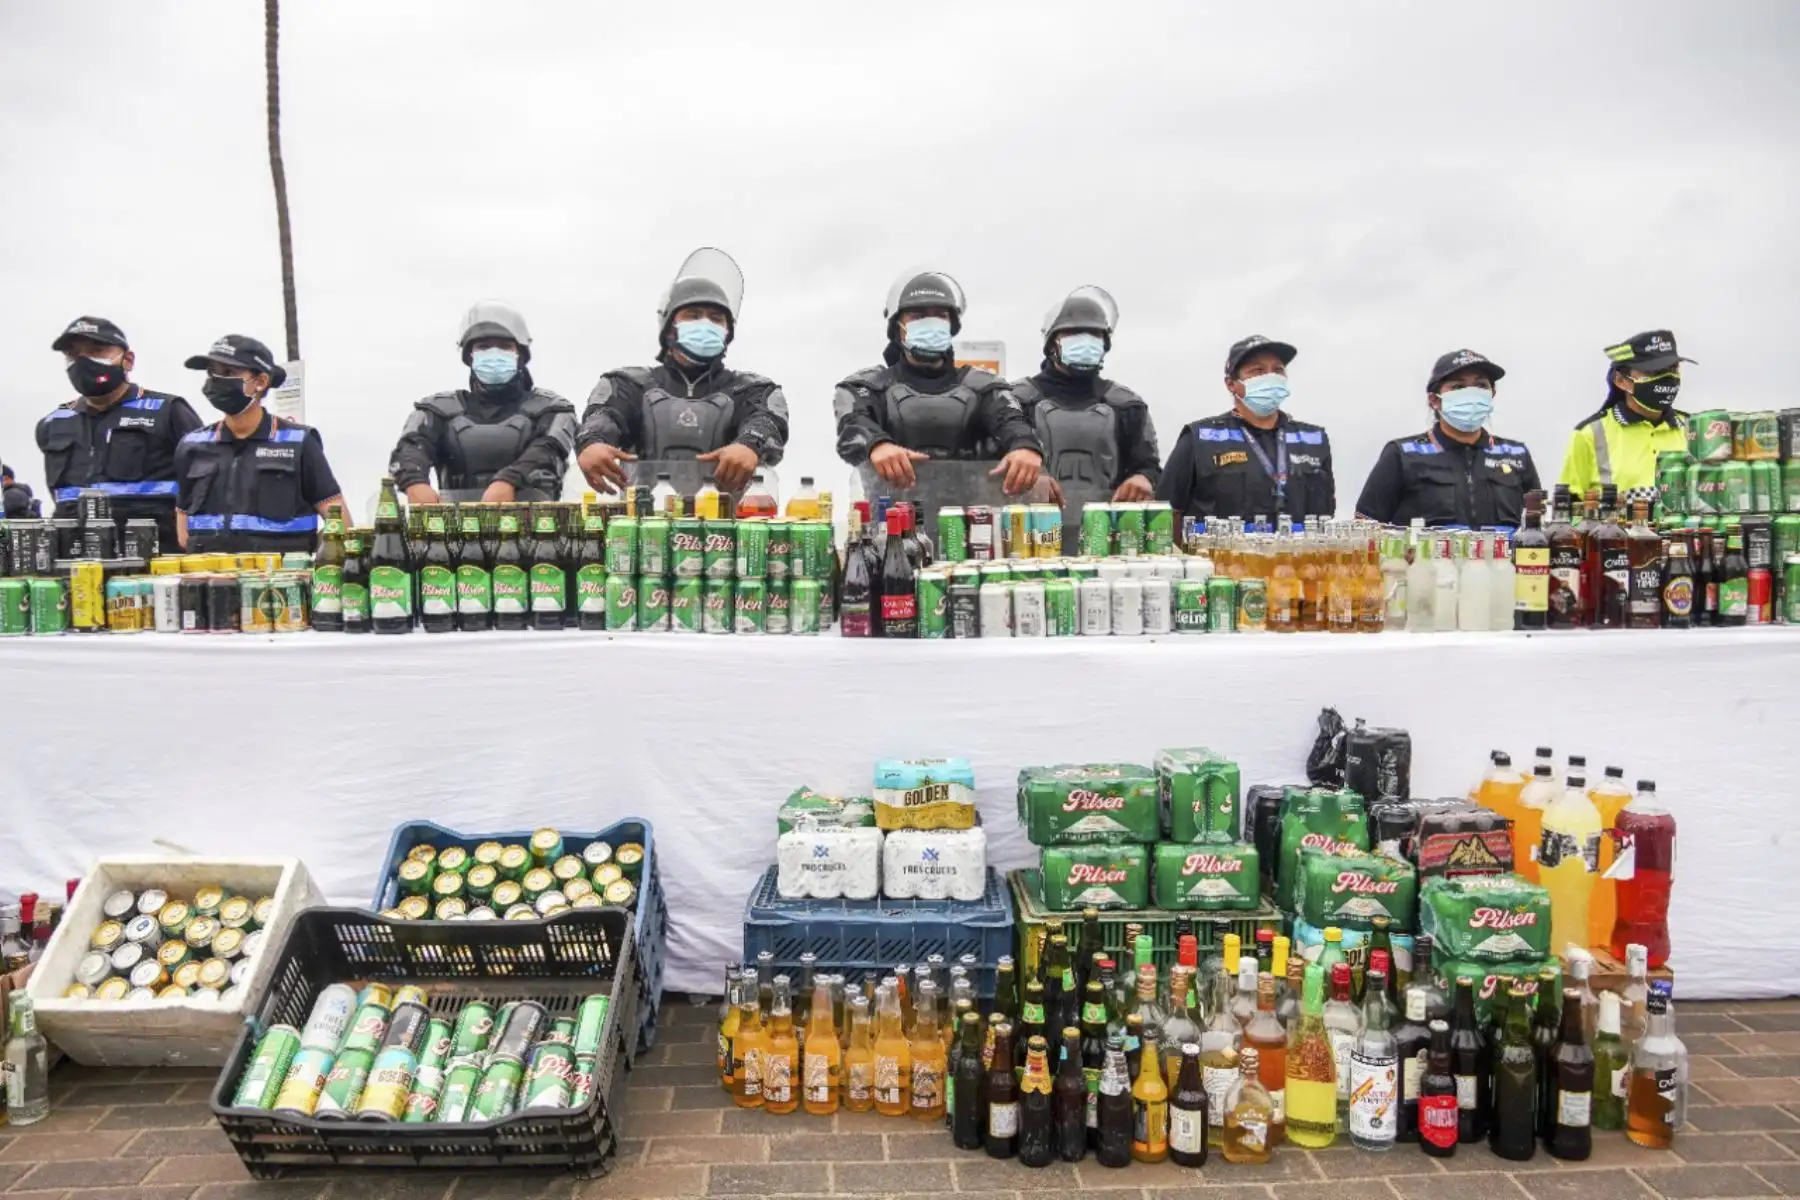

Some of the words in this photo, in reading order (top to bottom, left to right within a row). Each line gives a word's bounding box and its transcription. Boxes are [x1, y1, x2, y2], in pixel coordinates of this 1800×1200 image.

[904, 784, 949, 806] GOLDEN
[1062, 788, 1126, 812] Pilsen
[1067, 863, 1127, 886] Pilsen
[1182, 854, 1244, 879] Pilsen
[1331, 871, 1399, 893] Pilsen
[1469, 907, 1538, 929] Pilsen
